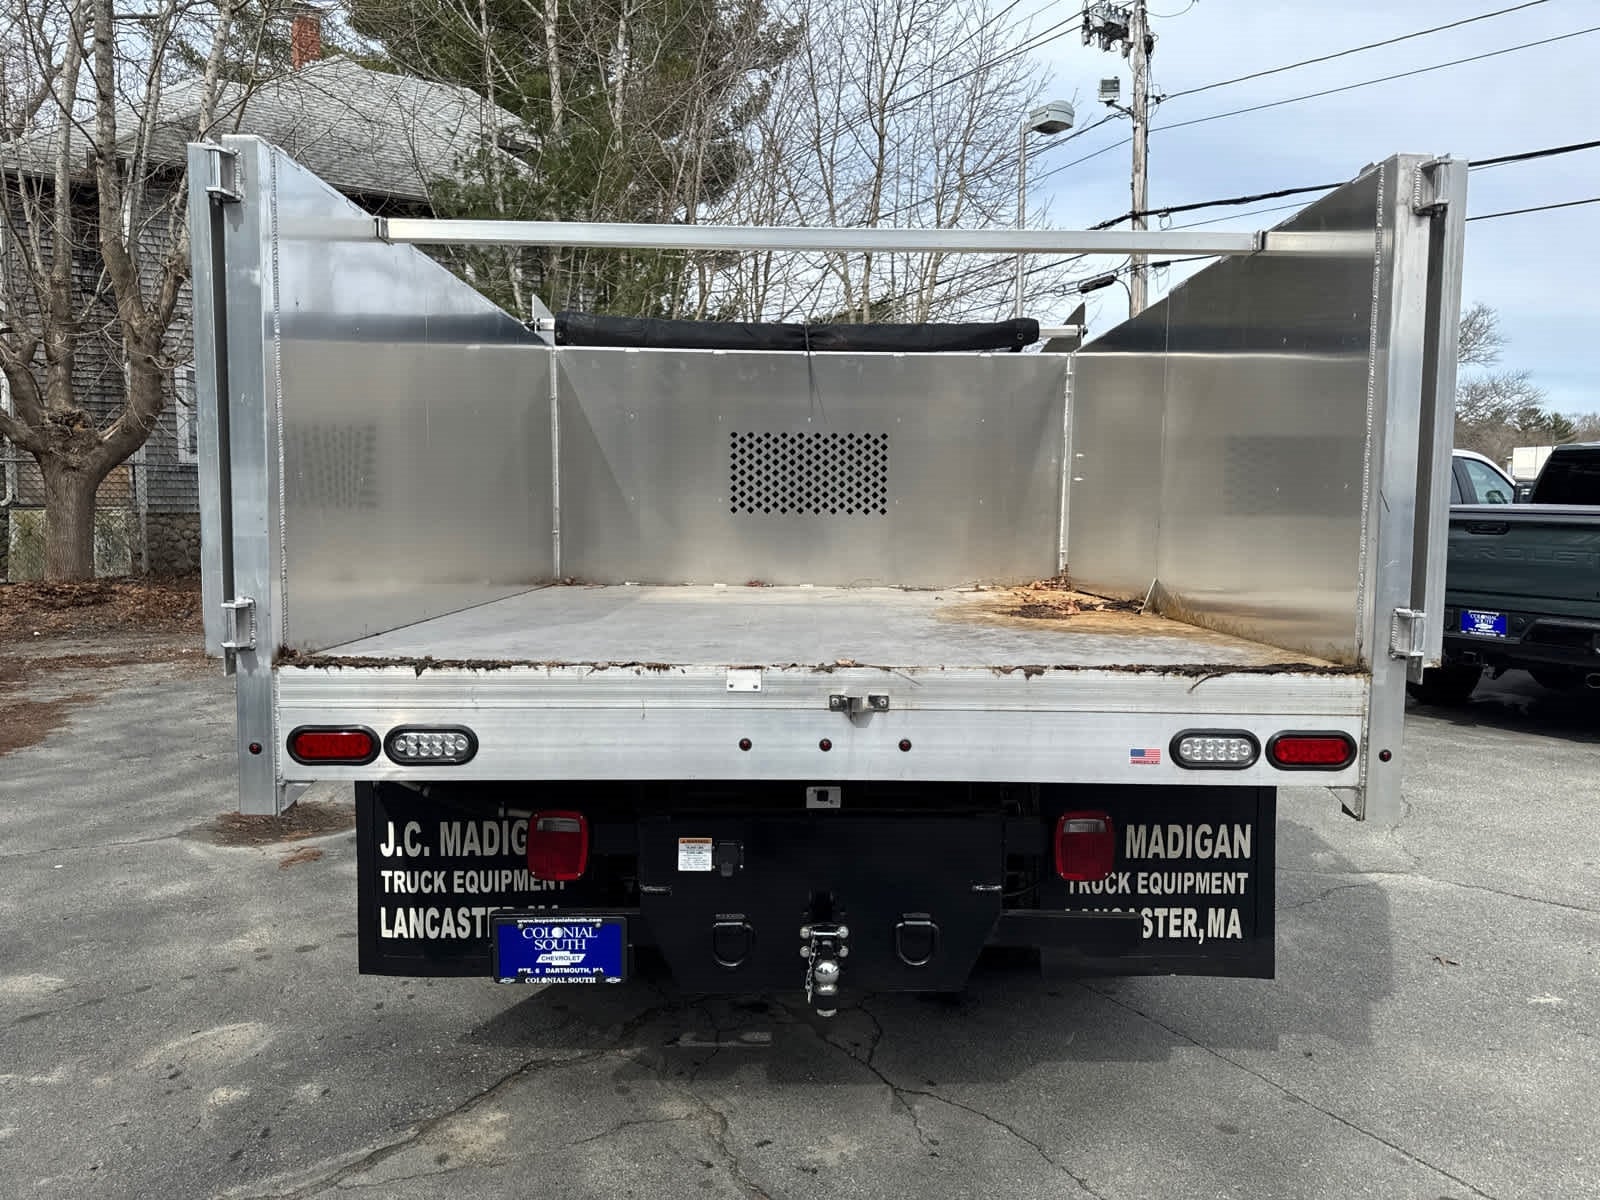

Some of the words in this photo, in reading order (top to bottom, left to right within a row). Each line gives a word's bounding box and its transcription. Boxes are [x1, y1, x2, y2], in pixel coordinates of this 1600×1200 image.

[380, 821, 430, 857] J.C.
[439, 820, 528, 857] MADIG
[1125, 824, 1251, 859] MADIGAN
[381, 870, 447, 893] TRUCK
[1137, 872, 1249, 895] EQUIPMENT
[380, 907, 515, 939] LANCAST
[522, 927, 598, 939] COLONIAL
[534, 939, 586, 951] SOUTH
